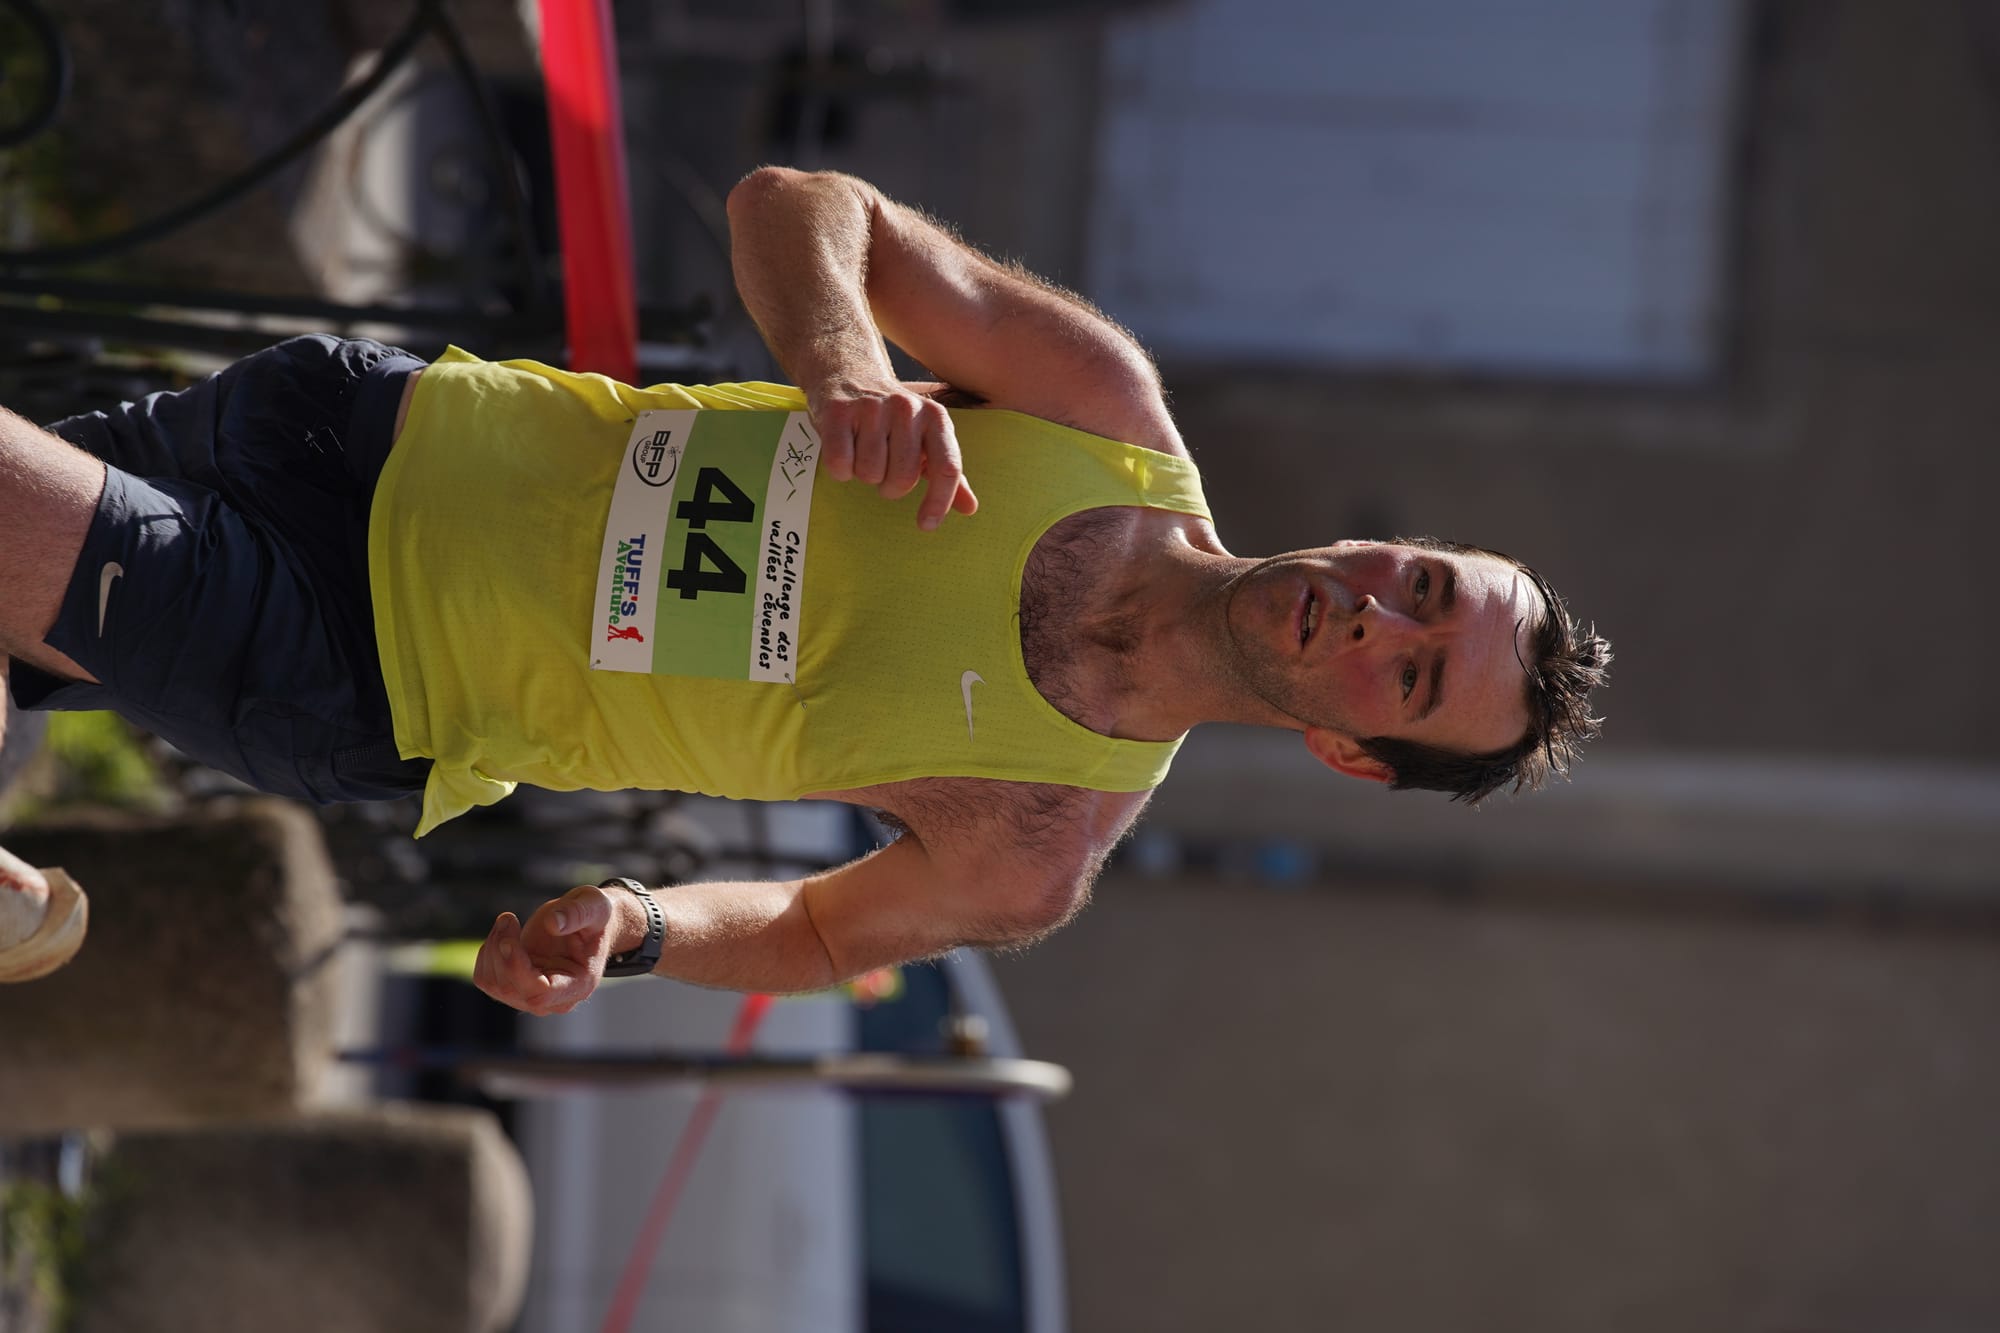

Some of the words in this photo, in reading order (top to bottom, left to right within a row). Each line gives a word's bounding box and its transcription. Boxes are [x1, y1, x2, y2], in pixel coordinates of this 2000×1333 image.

[640, 440, 652, 463] GROUP
[647, 430, 671, 478] BFP
[666, 467, 755, 600] 44
[765, 520, 782, 582] vallées
[609, 540, 632, 624] Aventure
[620, 534, 646, 617] TUFF'S
[776, 531, 800, 620] Challenge
[759, 592, 777, 670] cévenoles
[776, 631, 790, 662] des
